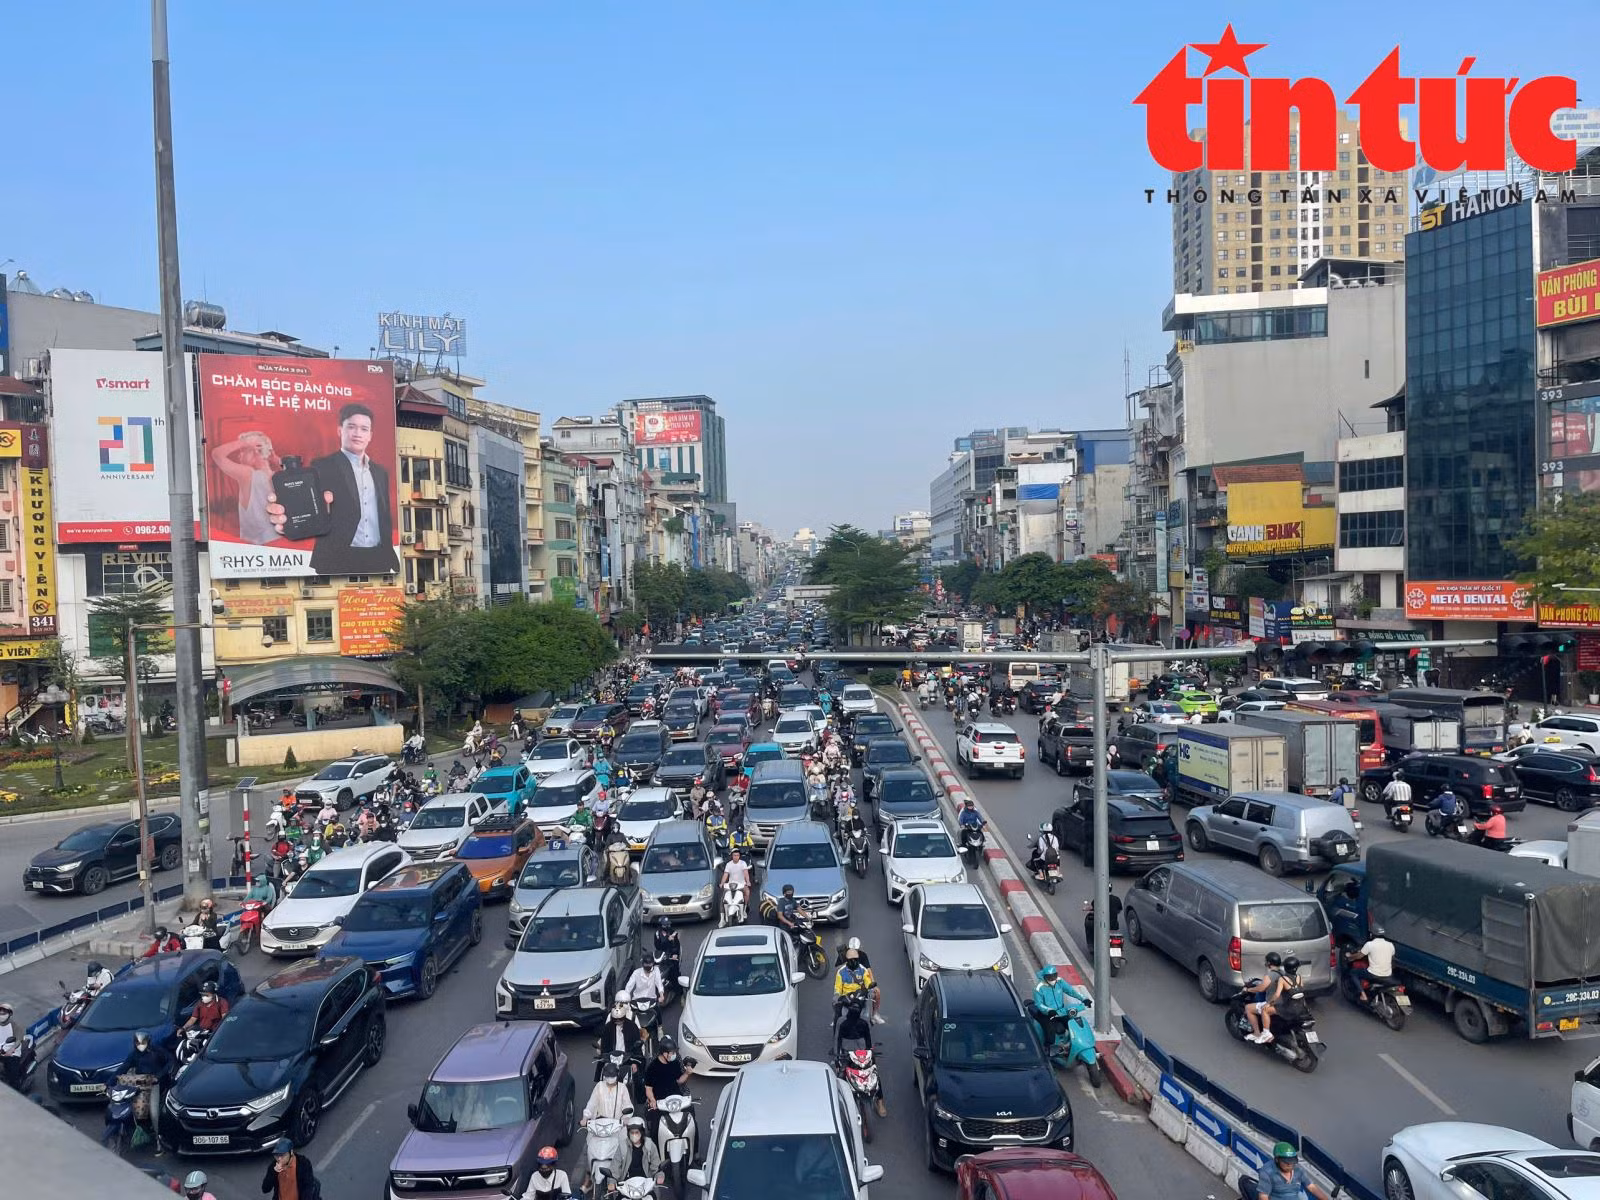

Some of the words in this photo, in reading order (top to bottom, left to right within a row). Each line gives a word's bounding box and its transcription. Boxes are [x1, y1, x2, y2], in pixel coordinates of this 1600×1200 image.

[1420, 204, 1447, 231] ST
[1541, 275, 1561, 297] VĂN
[1563, 268, 1598, 292] PHÒNG
[1554, 294, 1588, 318] BÙI
[380, 310, 423, 328] KÍNH
[428, 312, 464, 330] MẮT
[384, 330, 461, 352] LILY
[367, 365, 384, 373] FDA
[212, 374, 257, 389] CHĂM
[261, 377, 291, 391] SÓC
[294, 380, 322, 394] ĐÀN
[325, 381, 353, 397] ÔNG
[279, 394, 301, 412] HỆ
[304, 396, 331, 411] MỚI
[1541, 389, 1563, 401] 393
[1541, 461, 1564, 472] 393
[30, 476, 46, 546] KHƯƠNG
[135, 525, 172, 535] 0962.90
[220, 555, 264, 569] RHYS
[269, 553, 303, 567] MAN
[34, 551, 49, 597] VIÊN
[1430, 594, 1461, 605] META
[1464, 594, 1509, 605] DENTAL
[32, 616, 55, 627] 341
[7, 645, 31, 657] VIÊN
